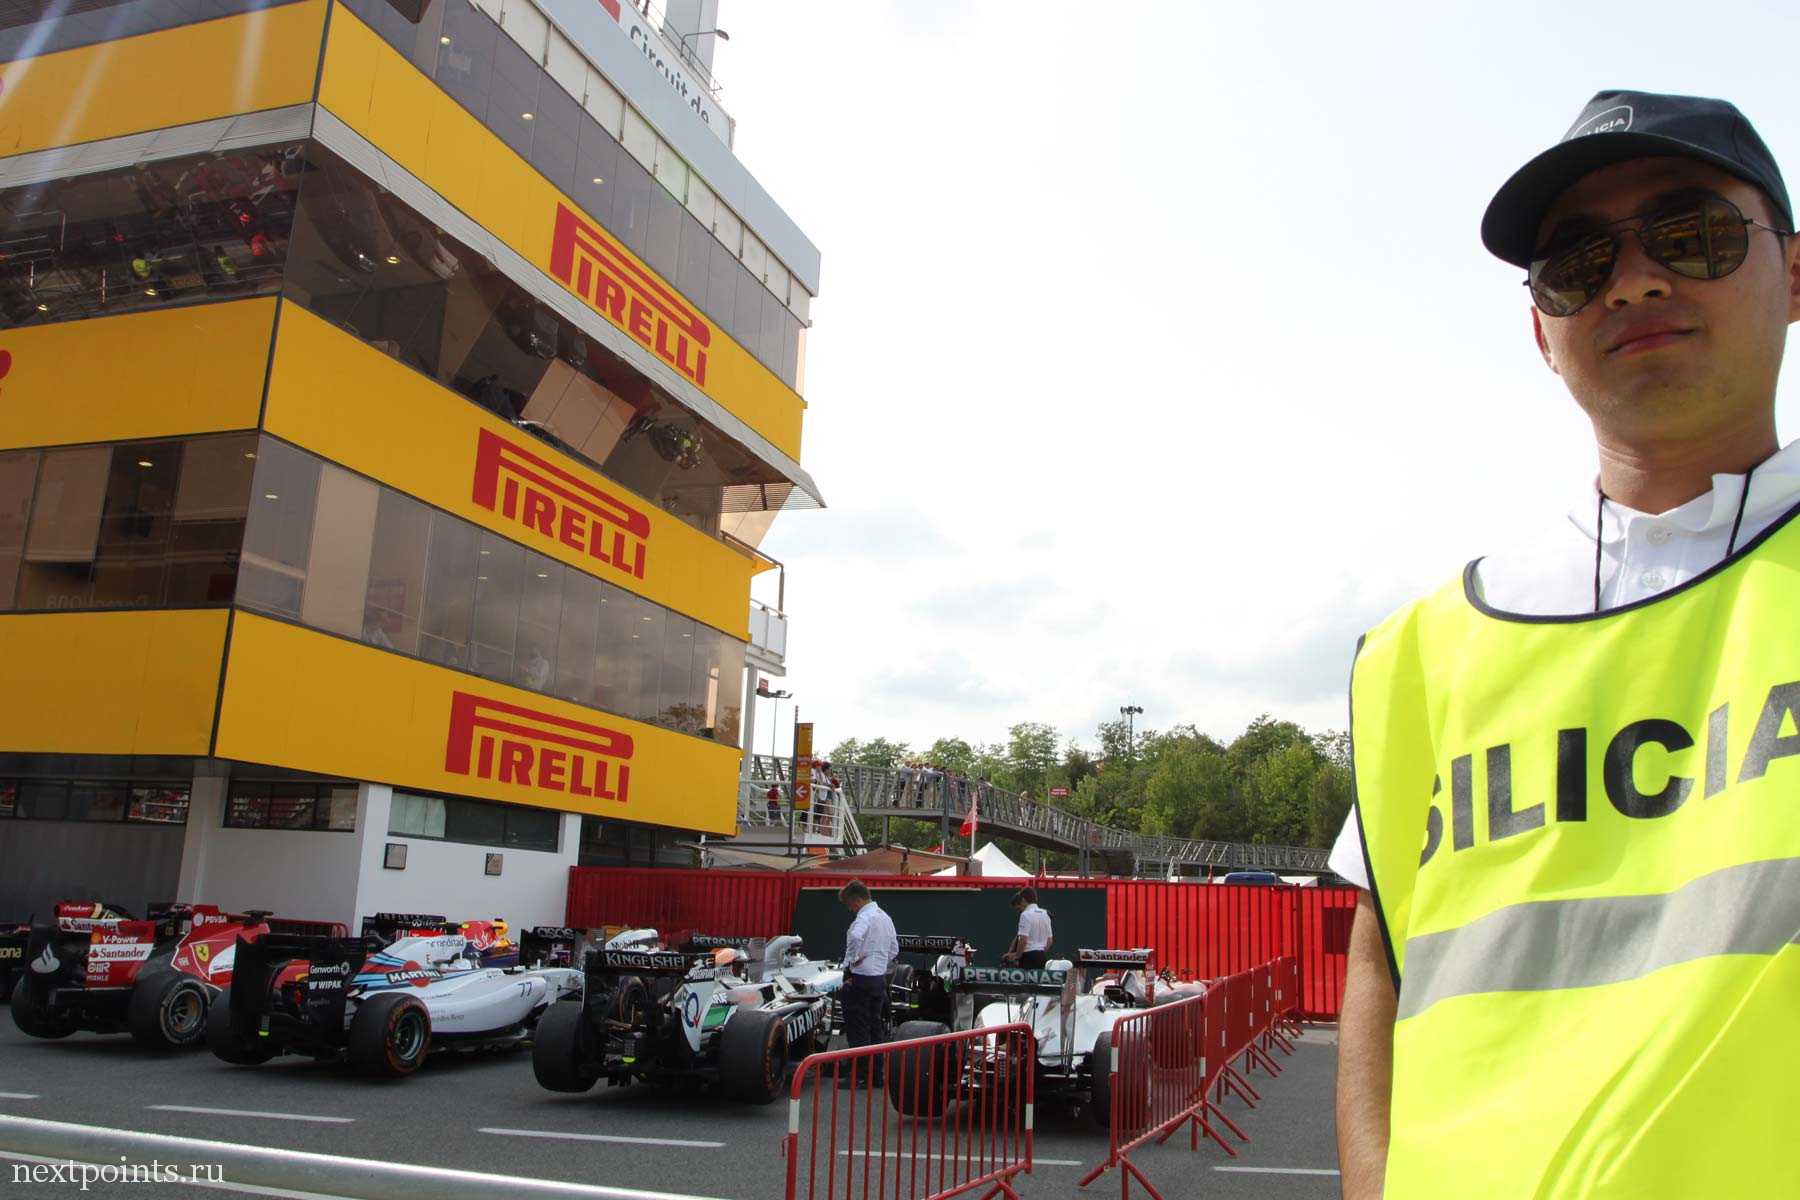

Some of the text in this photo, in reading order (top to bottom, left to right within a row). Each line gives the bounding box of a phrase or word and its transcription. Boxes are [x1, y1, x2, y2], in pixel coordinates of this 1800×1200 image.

[549, 201, 711, 387] PIRELLI
[472, 427, 650, 579] PIRELLI
[445, 691, 633, 802] PIRELLI
[102, 935, 138, 944] V-Power
[100, 947, 145, 958] Santander
[1094, 951, 1147, 961] Santander
[310, 964, 340, 974] Genworth
[963, 966, 1064, 985] PETRONAS
[389, 970, 441, 983] MARTINI
[318, 980, 343, 990] WIPAK
[517, 981, 533, 998] 77
